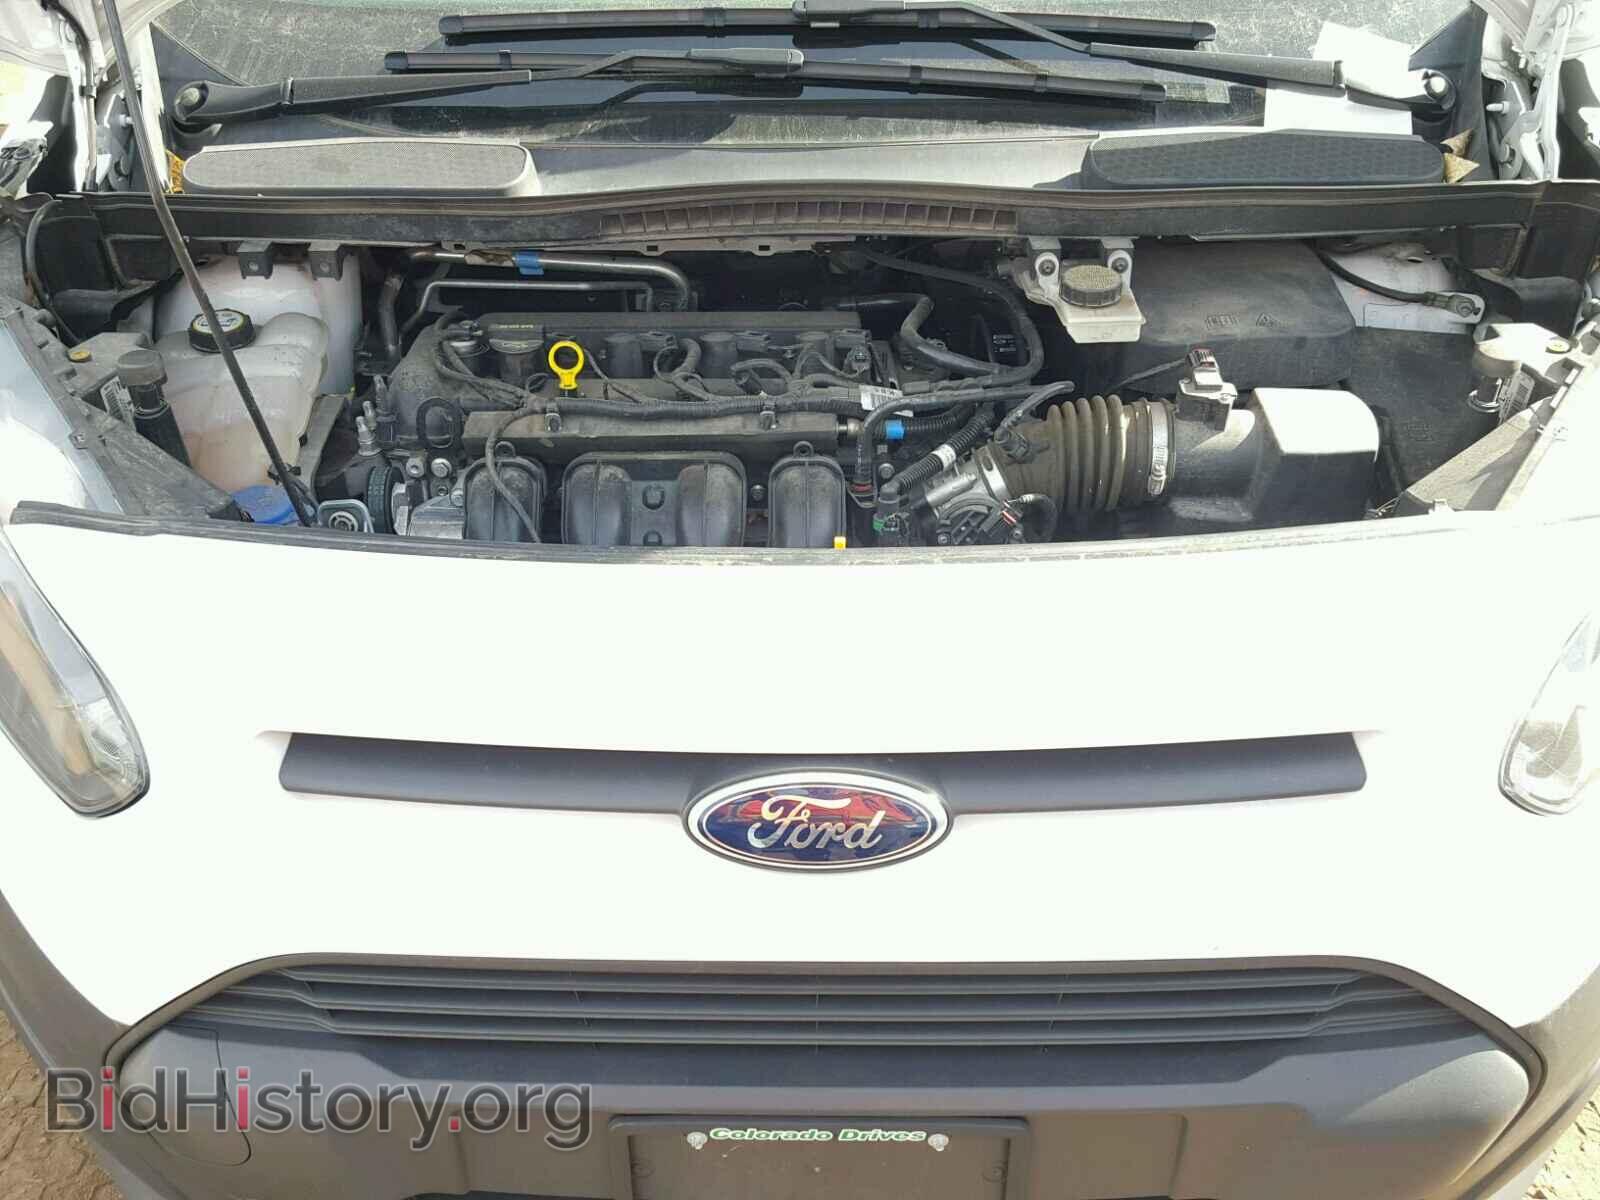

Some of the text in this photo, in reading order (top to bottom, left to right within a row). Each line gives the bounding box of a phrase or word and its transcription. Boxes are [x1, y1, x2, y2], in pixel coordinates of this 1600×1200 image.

[747, 795, 886, 848] Ford
[709, 1128, 927, 1142] Colorado Drives
